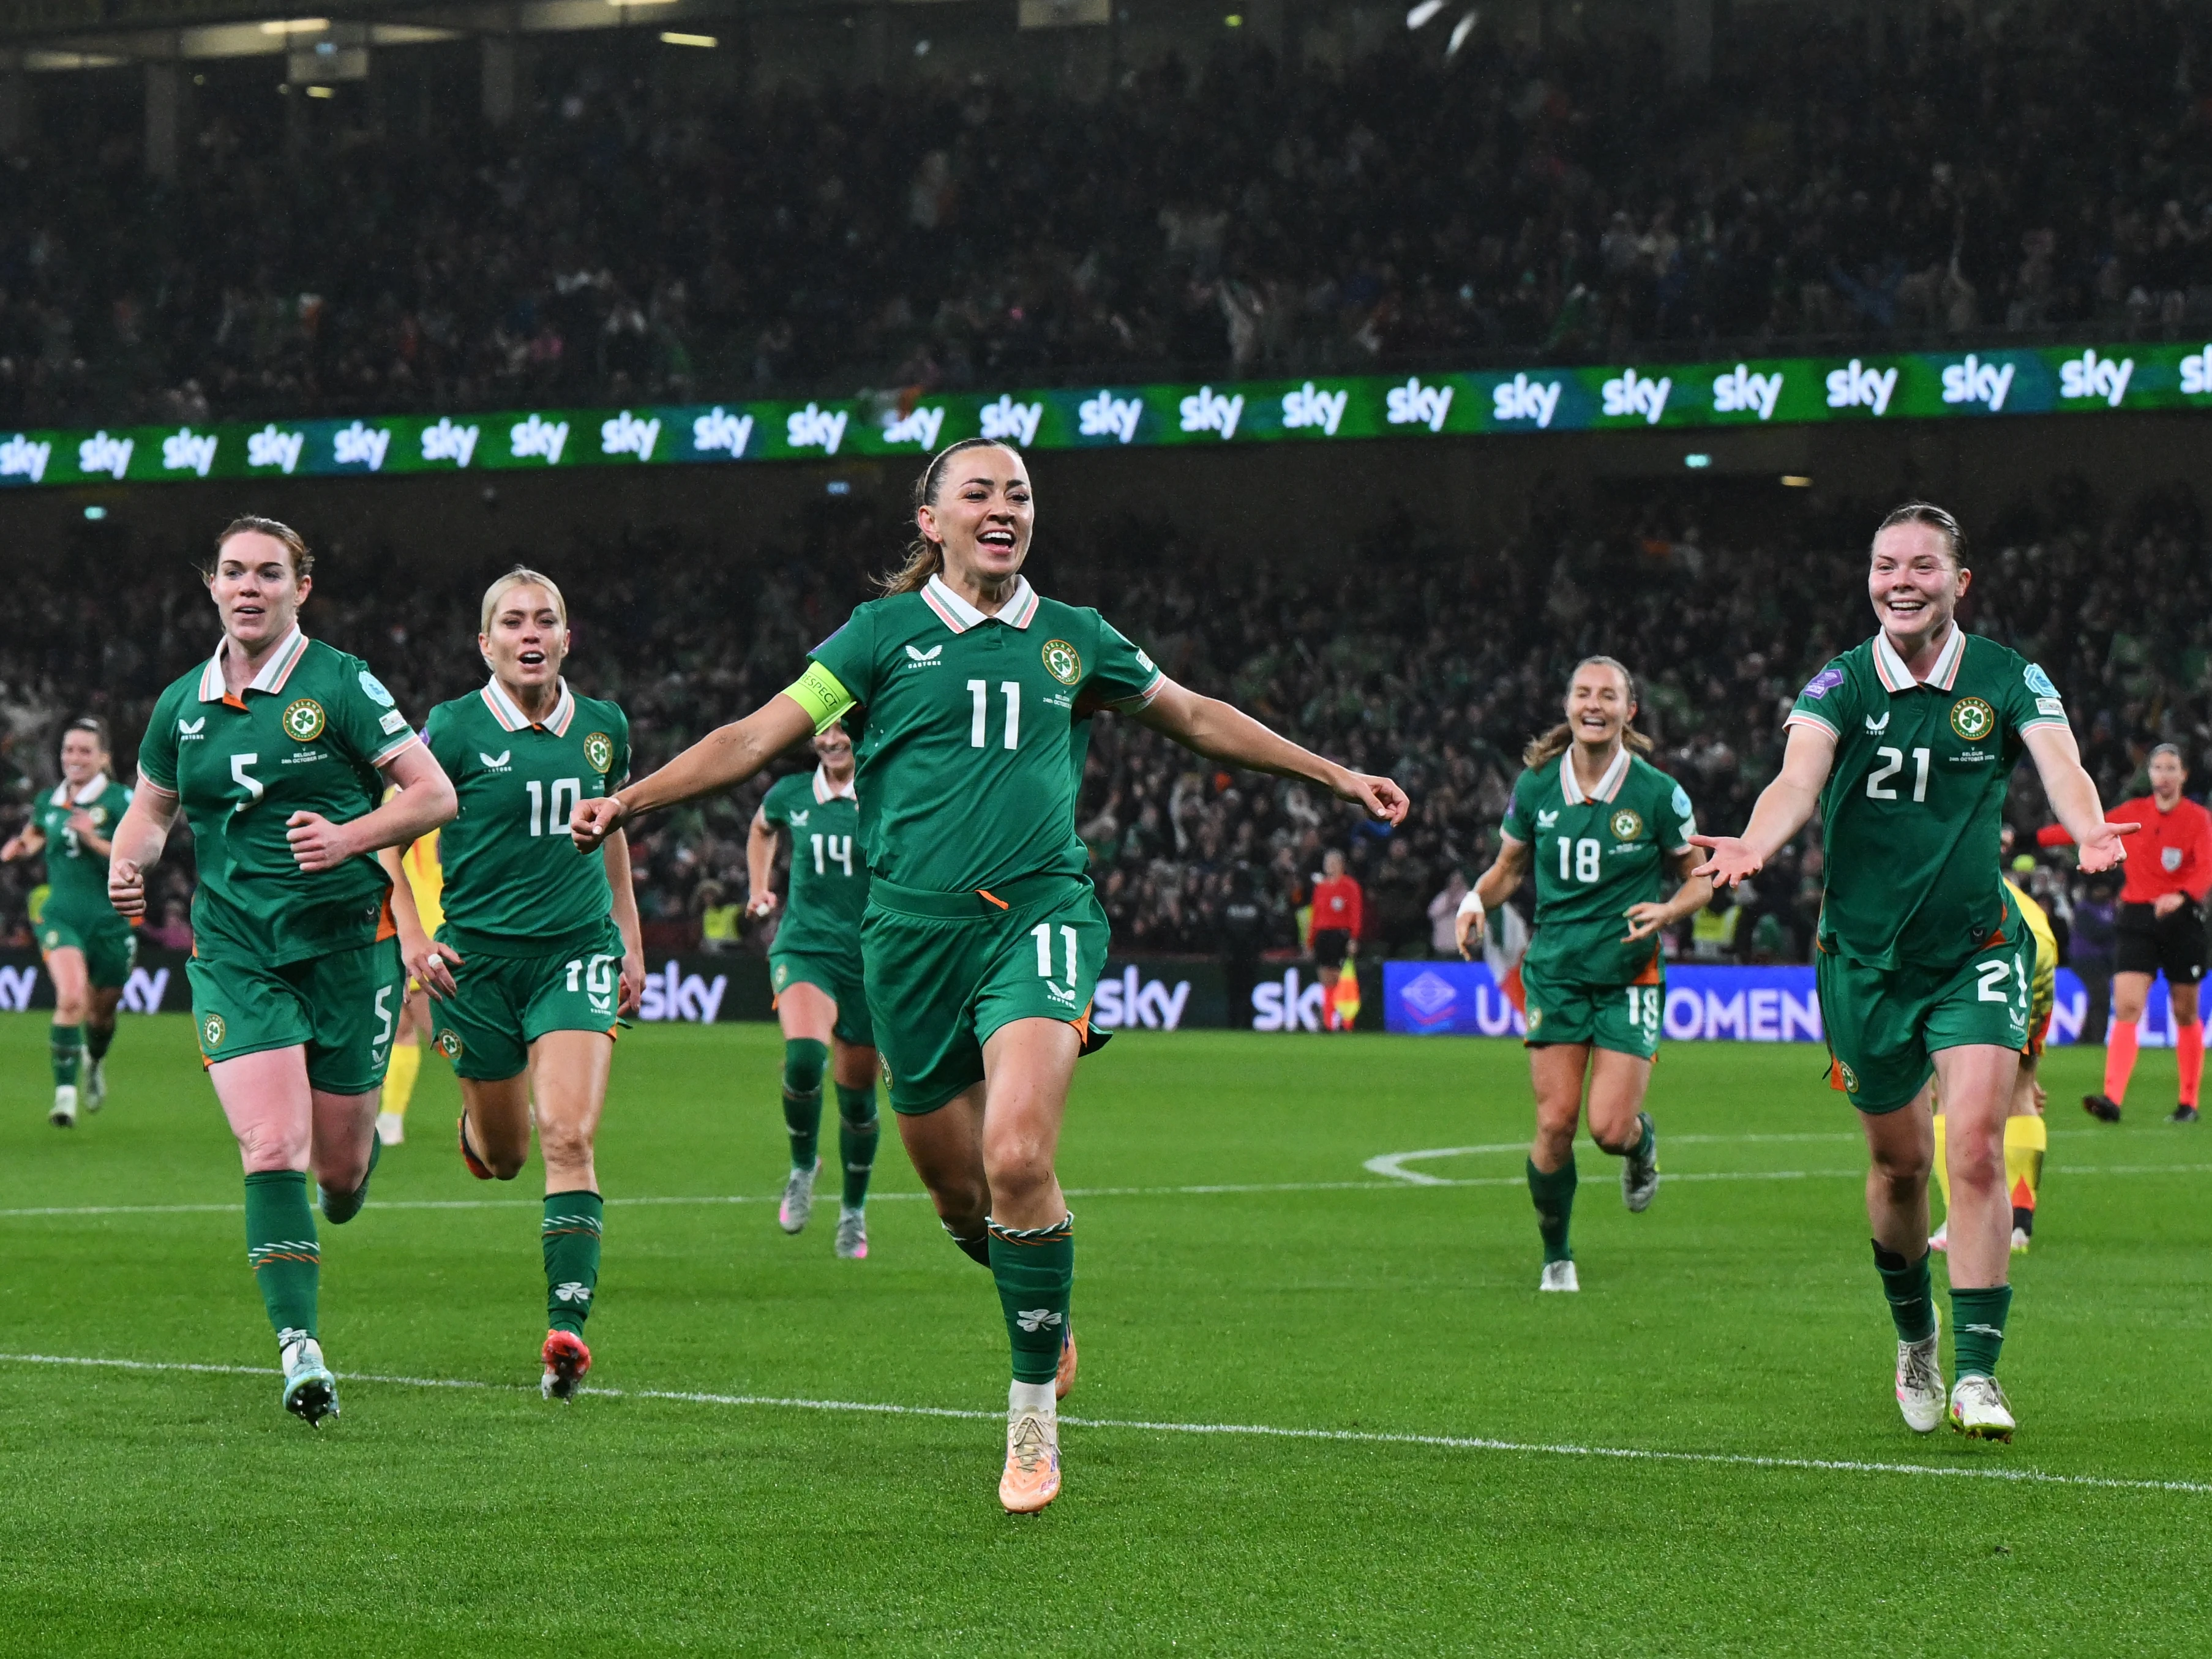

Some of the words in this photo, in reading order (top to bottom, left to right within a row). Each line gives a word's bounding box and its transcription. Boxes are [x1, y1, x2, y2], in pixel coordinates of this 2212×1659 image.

[0, 434, 51, 482] sky
[79, 432, 134, 479] sky
[163, 428, 218, 476] sky
[247, 424, 304, 473] sky
[334, 421, 391, 470] sky
[422, 418, 479, 466] sky
[511, 414, 569, 463] sky
[602, 411, 661, 460] sky
[694, 407, 754, 457] sky
[787, 403, 848, 454] sky
[980, 394, 1043, 448] sky
[1079, 390, 1142, 443] sky
[1180, 386, 1244, 440] sky
[1283, 381, 1348, 435] sky
[1387, 377, 1453, 432] sky
[1493, 373, 1561, 427] sky
[1603, 368, 1671, 424] sky
[1714, 364, 1783, 419] sky
[1827, 358, 1898, 415] sky
[1942, 354, 2015, 411] sky
[2061, 348, 2134, 406] sky
[1044, 642, 1076, 659] IRELAND
[287, 701, 320, 715] IRELAND
[966, 679, 1020, 750] 11
[1954, 700, 1989, 713] IRELAND
[230, 753, 264, 812] 5
[1866, 746, 1930, 802] 21
[525, 777, 581, 837] 10
[810, 834, 853, 877] 14
[1557, 836, 1601, 883] 18
[565, 953, 615, 994] 10
[1030, 923, 1077, 987] 11
[1975, 952, 2028, 1008] 21
[372, 985, 392, 1046] 5
[639, 960, 727, 1025] sky
[1093, 964, 1191, 1031] sky
[1251, 967, 1341, 1032] sk
[1625, 986, 1659, 1030] 18
